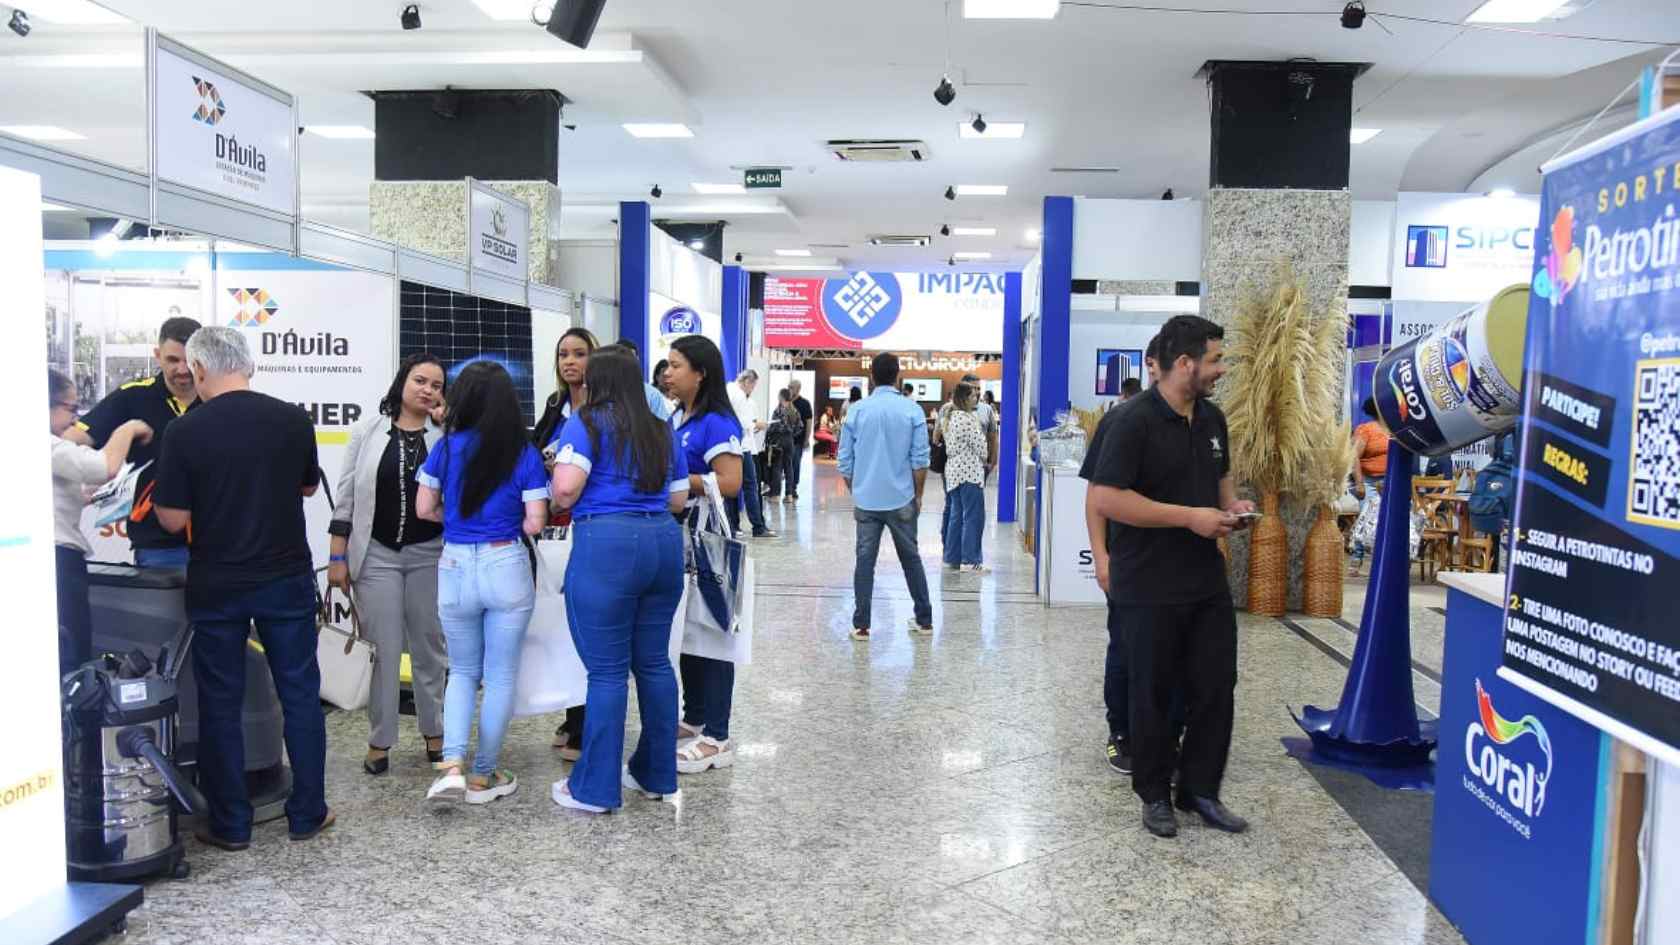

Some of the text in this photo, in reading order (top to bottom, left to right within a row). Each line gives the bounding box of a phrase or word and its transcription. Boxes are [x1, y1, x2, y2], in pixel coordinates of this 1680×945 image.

[215, 133, 266, 173] D'Ávila
[756, 173, 781, 184] SAÍDA
[262, 328, 348, 356] D'Ávila
[671, 318, 692, 330] ISO
[1541, 386, 1601, 430] PARTICIPE!
[1543, 443, 1589, 485] REGRAS:
[1512, 550, 1567, 578] INSTAGRAM
[1565, 537, 1632, 571] PETROTINTAS
[1633, 553, 1653, 574] NO
[1529, 624, 1579, 659] POSTAGEM
[1579, 643, 1596, 664] NO
[1597, 652, 1635, 680] STORY
[1634, 666, 1654, 690] OU
[1562, 612, 1589, 636] FOTO
[1590, 622, 1646, 657] CONOSCO
[1647, 642, 1656, 661] E
[1506, 640, 1598, 692] NOS MENCIONANDO
[1465, 722, 1534, 817] Coral
